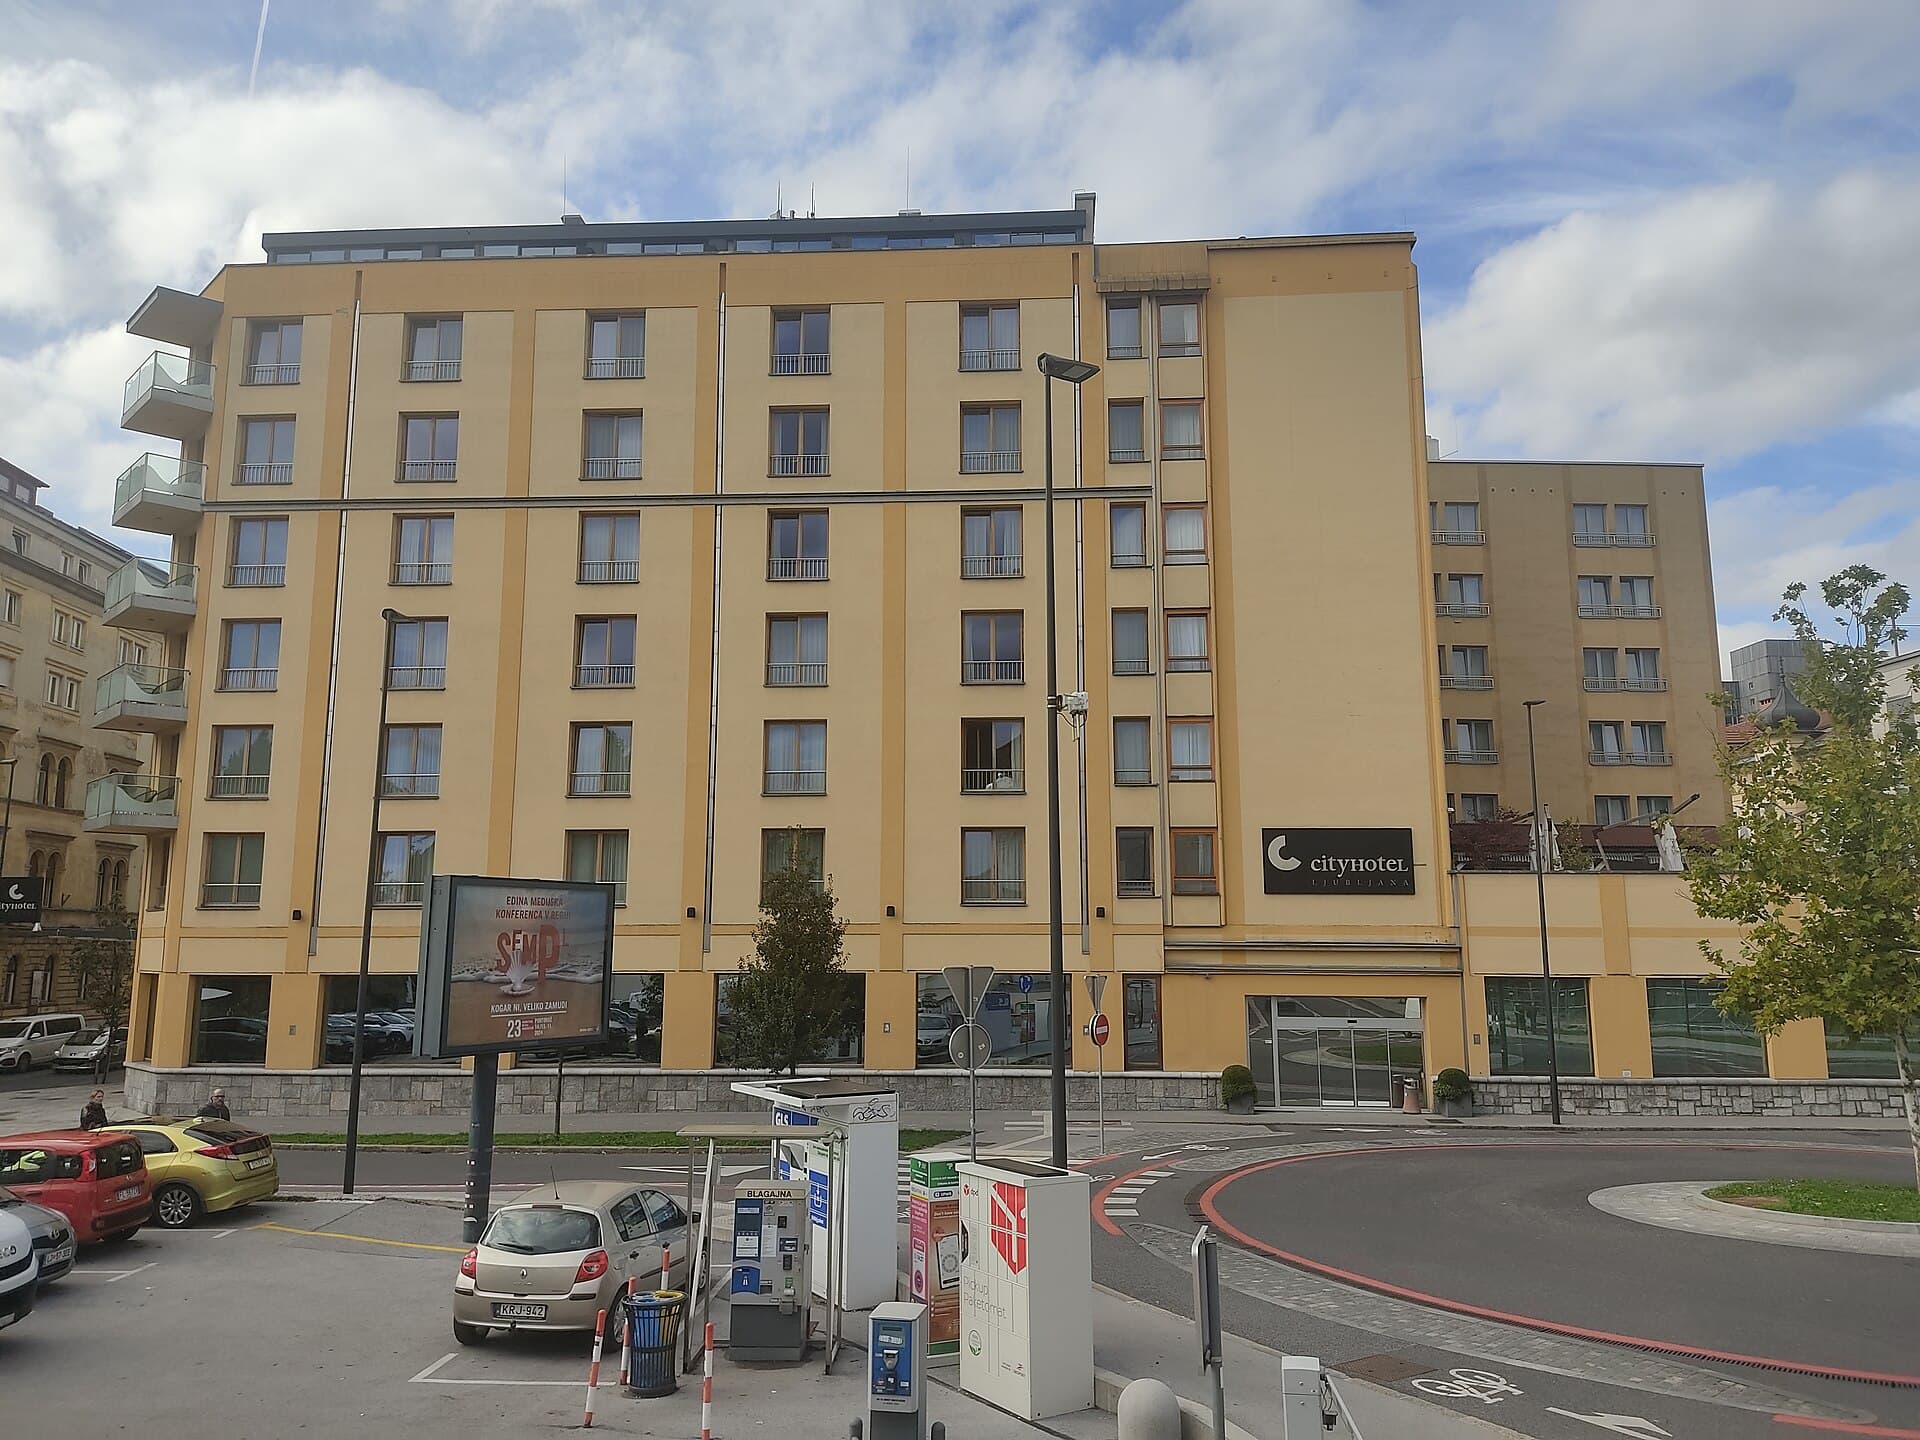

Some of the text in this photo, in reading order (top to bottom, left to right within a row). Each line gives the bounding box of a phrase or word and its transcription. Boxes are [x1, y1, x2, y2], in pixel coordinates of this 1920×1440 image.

[1311, 879, 1410, 887] LJUBLJANA
[506, 896, 564, 907] EDINA MEDIJSKA
[495, 908, 543, 920] KONFERENCA
[490, 1003, 512, 1014] KOGAR
[523, 1002, 544, 1012] VELIKO
[544, 1000, 568, 1011] ZAMUDI
[775, 1112, 789, 1126] GLS
[746, 1190, 793, 1198] BLAGAJNA
[501, 1304, 544, 1316] KRJ-942
